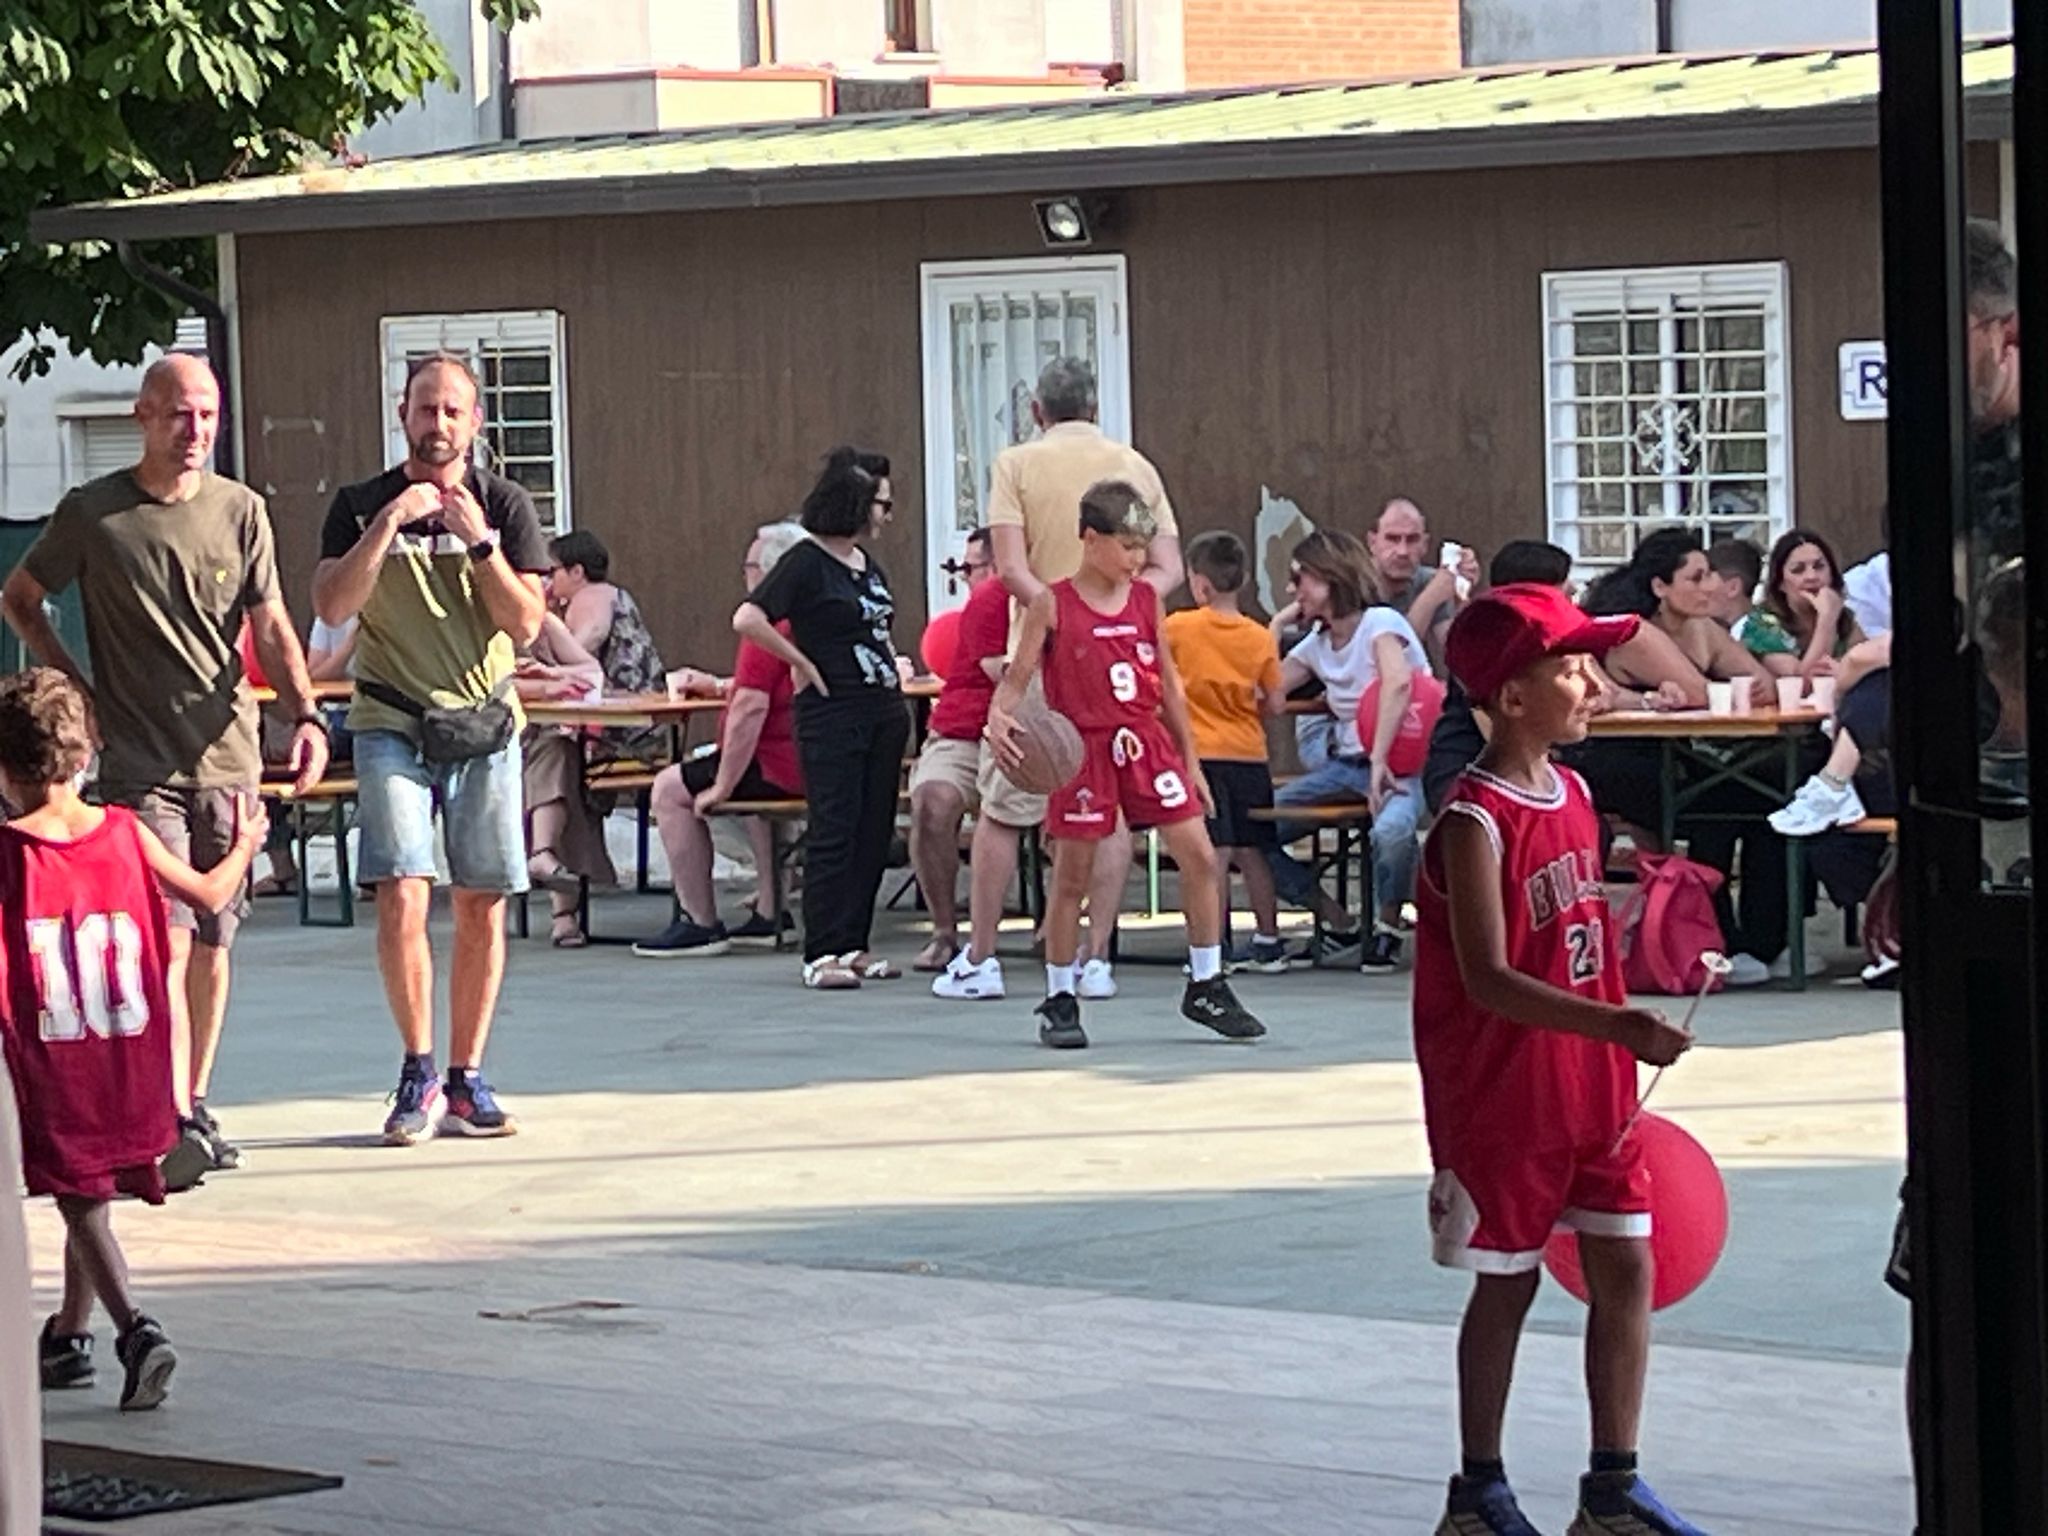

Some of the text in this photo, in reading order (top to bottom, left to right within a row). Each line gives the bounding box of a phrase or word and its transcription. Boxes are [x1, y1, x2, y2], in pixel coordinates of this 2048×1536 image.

[1109, 661, 1137, 702] 9
[1154, 770, 1188, 808] 9
[25, 911, 149, 1042] 10
